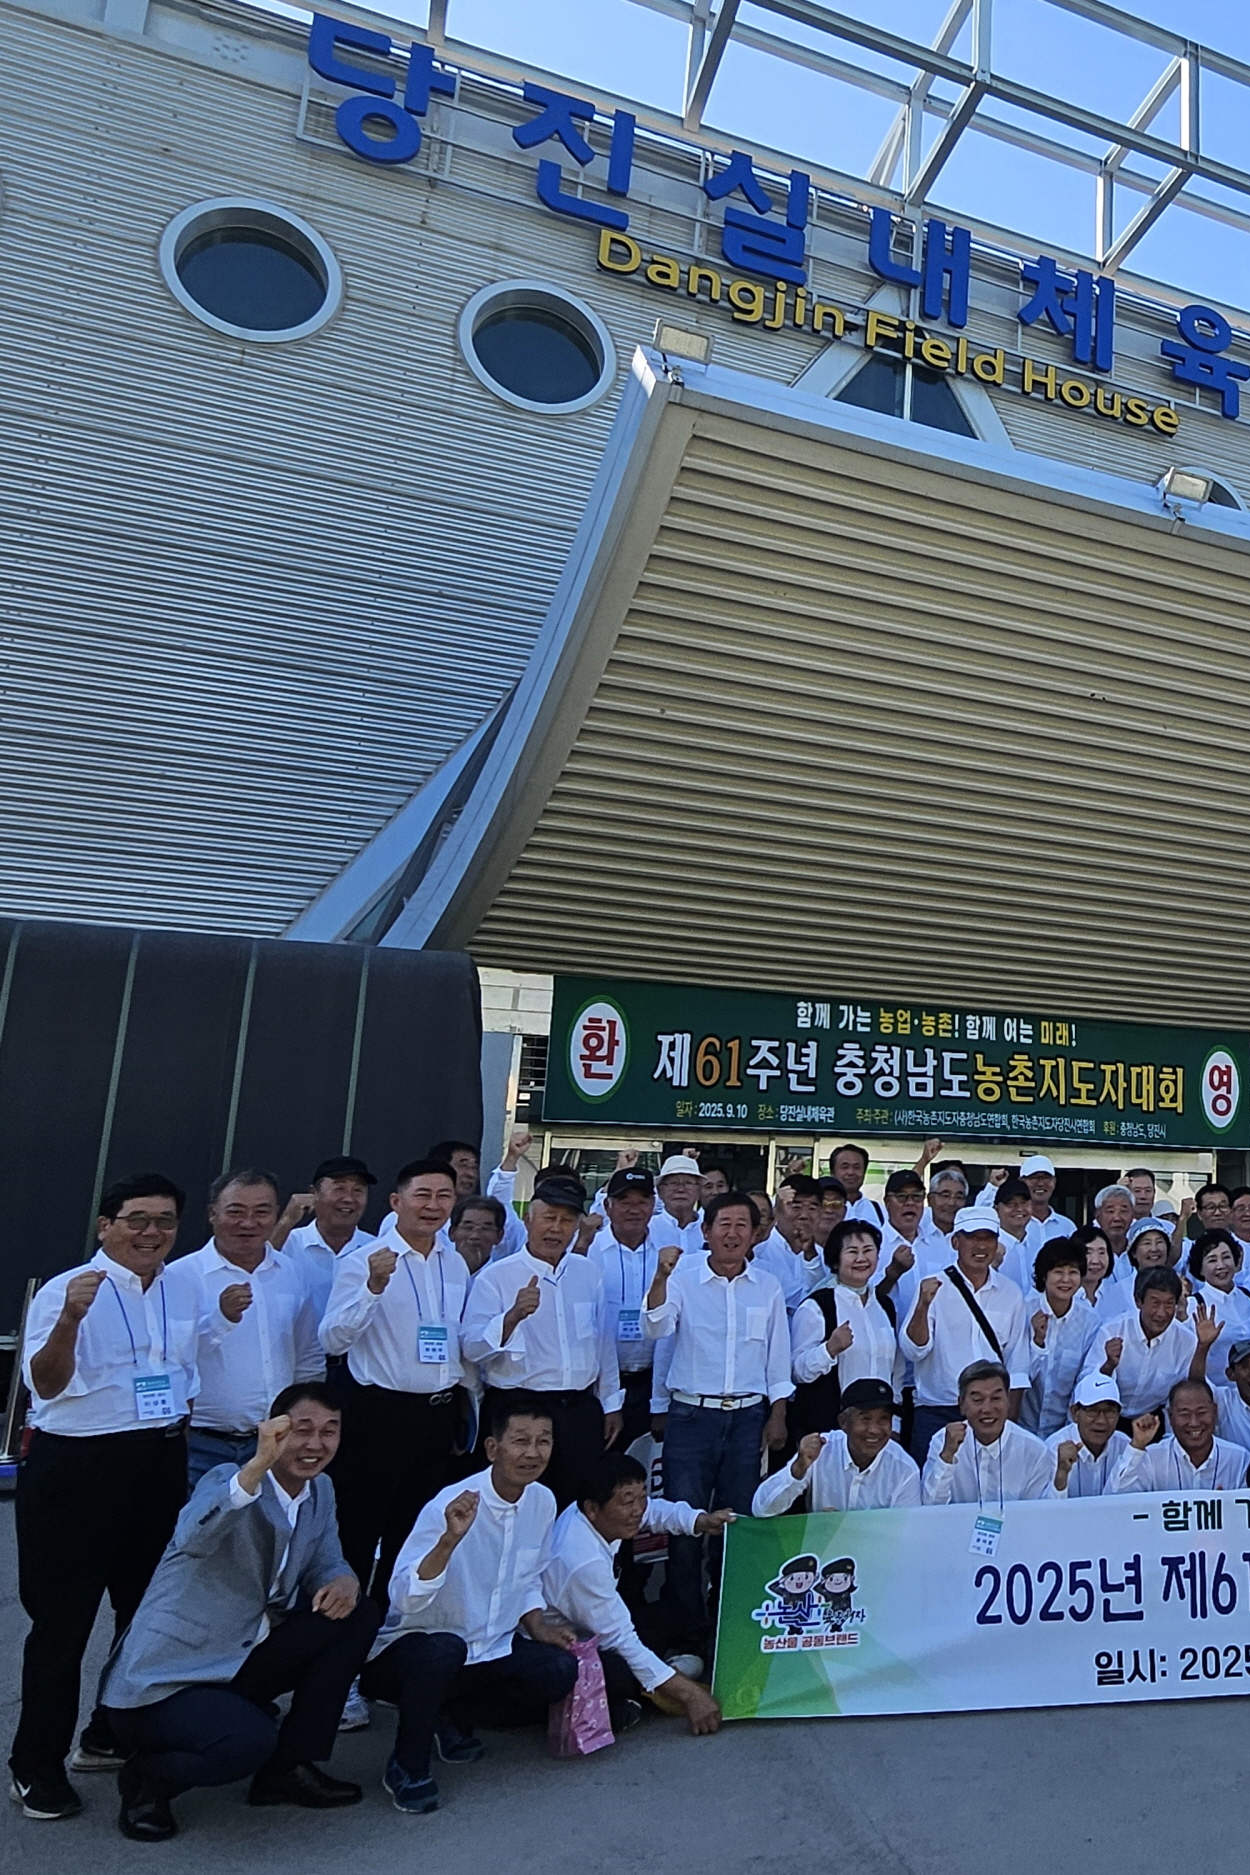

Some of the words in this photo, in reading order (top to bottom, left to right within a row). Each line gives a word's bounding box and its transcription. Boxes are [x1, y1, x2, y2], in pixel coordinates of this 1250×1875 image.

[597, 229, 846, 336] Dangjin
[865, 312, 1005, 384] Field
[1021, 358, 1181, 438] House
[579, 1017, 620, 1080] 환
[796, 1001, 831, 1030] 함께
[838, 1005, 872, 1033] 가는
[879, 1007, 960, 1040] 농업·농촌!
[965, 1014, 997, 1042] 함께
[1003, 1018, 1034, 1045] 여는
[1039, 1021, 1078, 1048] 미래!
[653, 1032, 819, 1093] 제61주년
[833, 1042, 1185, 1114] 충청남도농촌지도자대회
[1206, 1063, 1233, 1118] 영
[780, 1104, 836, 1123] 당진실내체육관
[1161, 1499, 1222, 1532] 함께
[974, 1552, 1144, 1626] 2025년
[1094, 1648, 1168, 1687] 일시:
